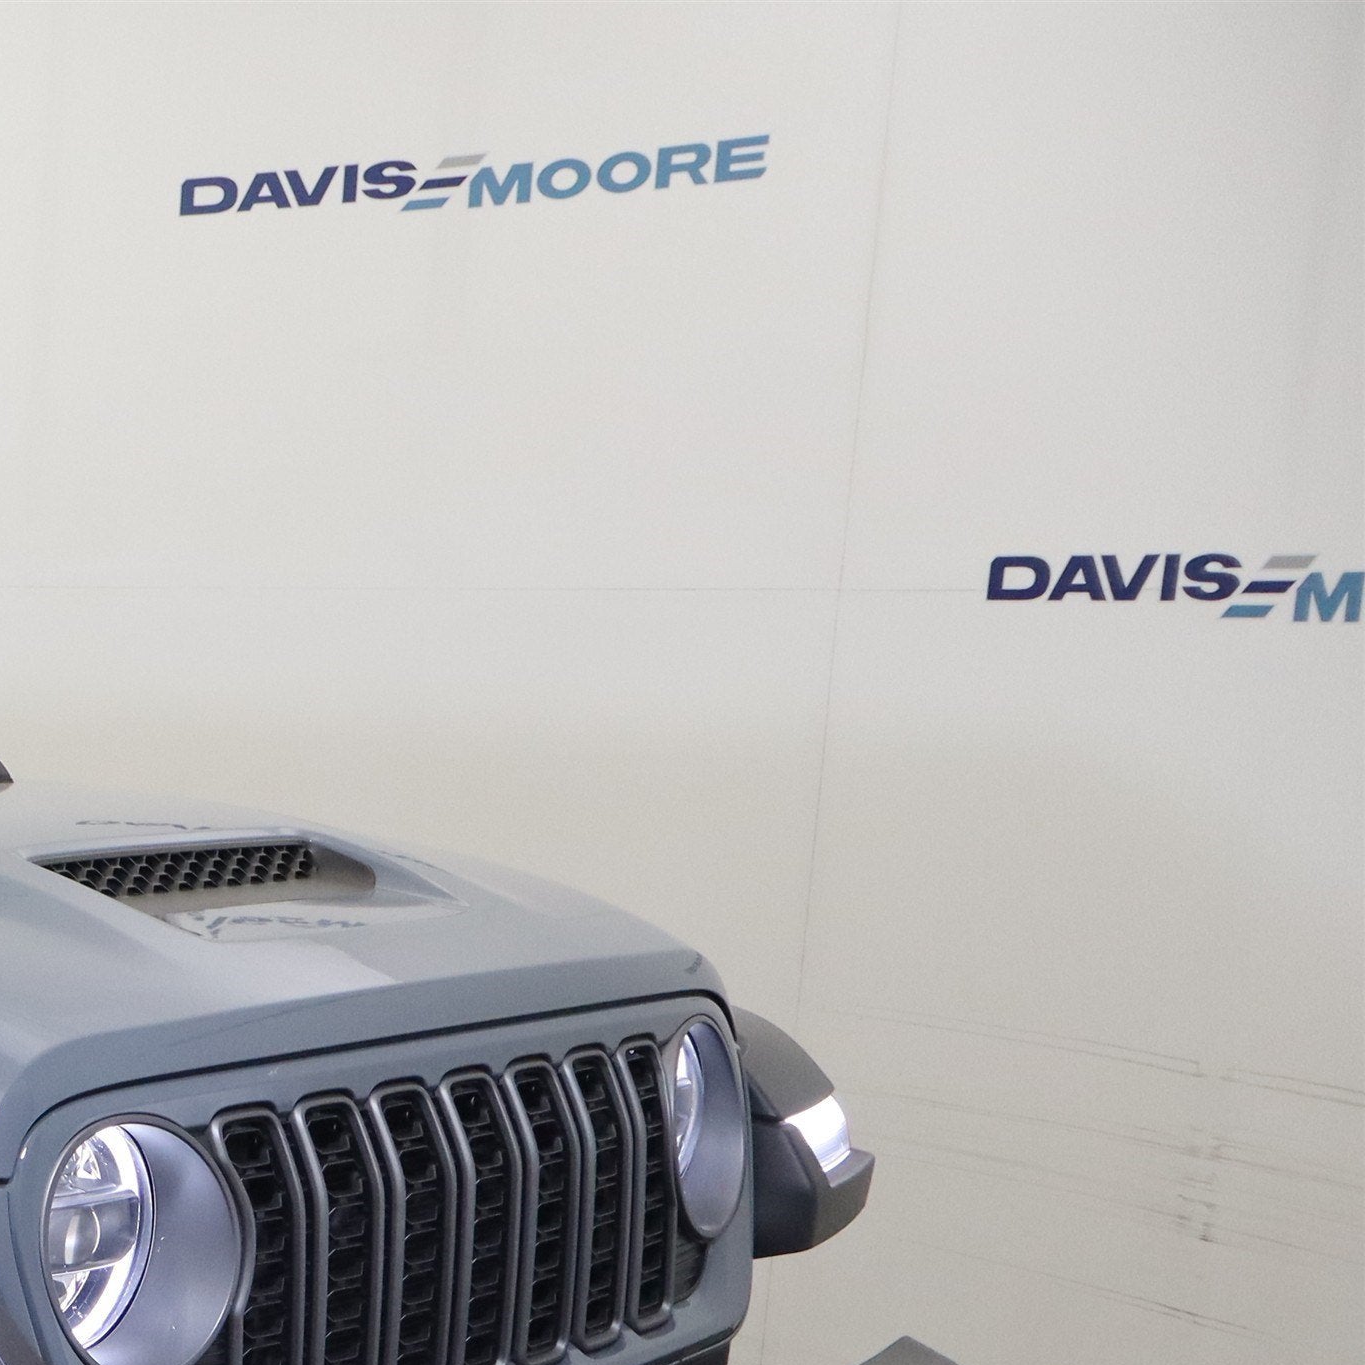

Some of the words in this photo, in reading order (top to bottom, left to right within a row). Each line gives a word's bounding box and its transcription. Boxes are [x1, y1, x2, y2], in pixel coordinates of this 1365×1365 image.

[178, 158, 421, 217] DAVIS
[466, 134, 771, 209] MOORE
[986, 552, 1243, 602] DAVIS
